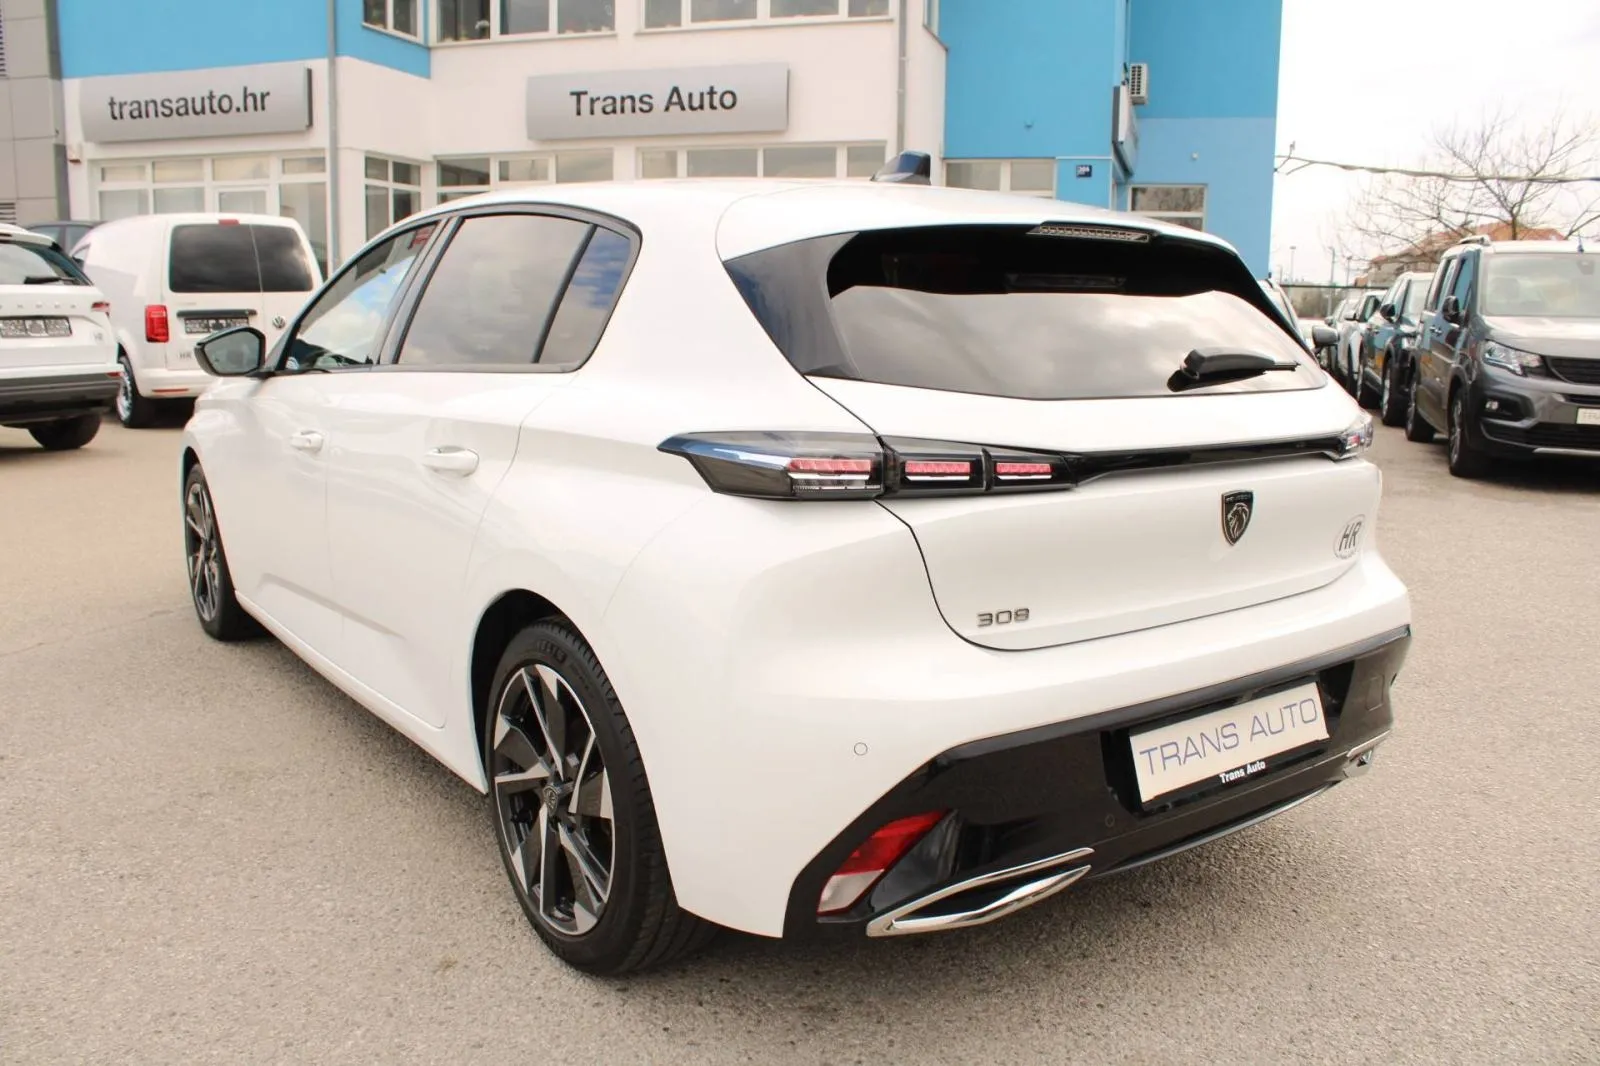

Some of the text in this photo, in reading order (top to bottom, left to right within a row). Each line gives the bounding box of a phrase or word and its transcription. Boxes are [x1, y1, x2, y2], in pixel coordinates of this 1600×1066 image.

[108, 86, 271, 121] transauto.hr
[569, 85, 738, 116] Trans Auto
[1338, 521, 1362, 552] HR
[977, 608, 1030, 628] 308
[1139, 698, 1318, 775] TRANS AUTO
[1219, 760, 1266, 784] Trans Auto
